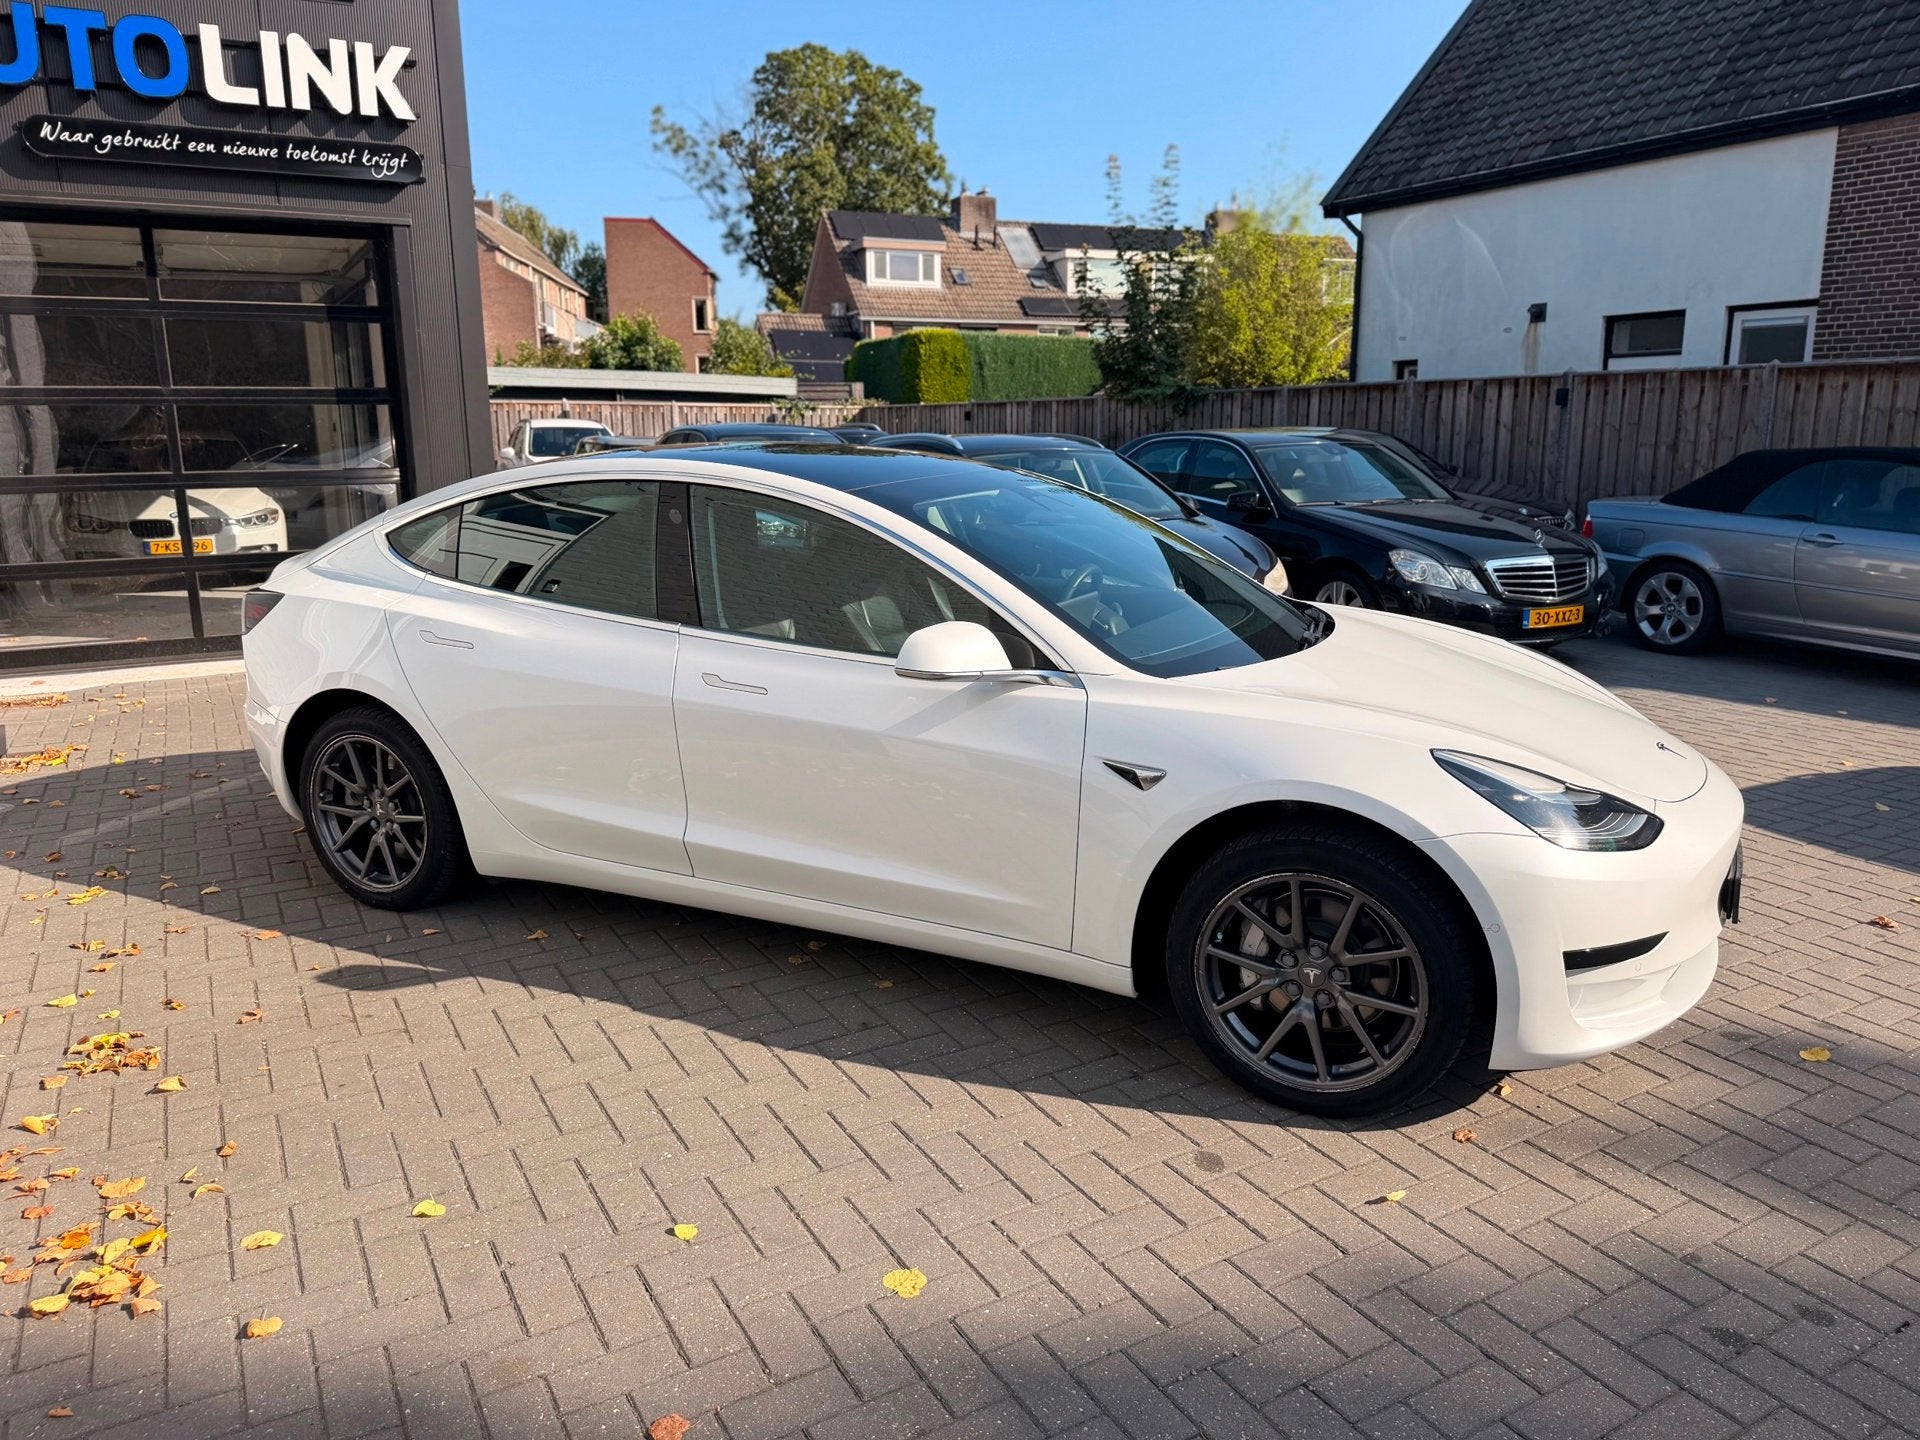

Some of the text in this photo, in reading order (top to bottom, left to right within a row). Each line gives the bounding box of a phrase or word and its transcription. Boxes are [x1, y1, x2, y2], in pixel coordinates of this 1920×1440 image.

[39, 121, 93, 143] Waar
[94, 129, 182, 154] gebruikt
[187, 140, 217, 153] een
[222, 141, 279, 159] nieuwe
[286, 143, 357, 165] toekomst
[153, 541, 208, 552] 7-KS96
[1534, 608, 1580, 624] 30-XXZ-3
